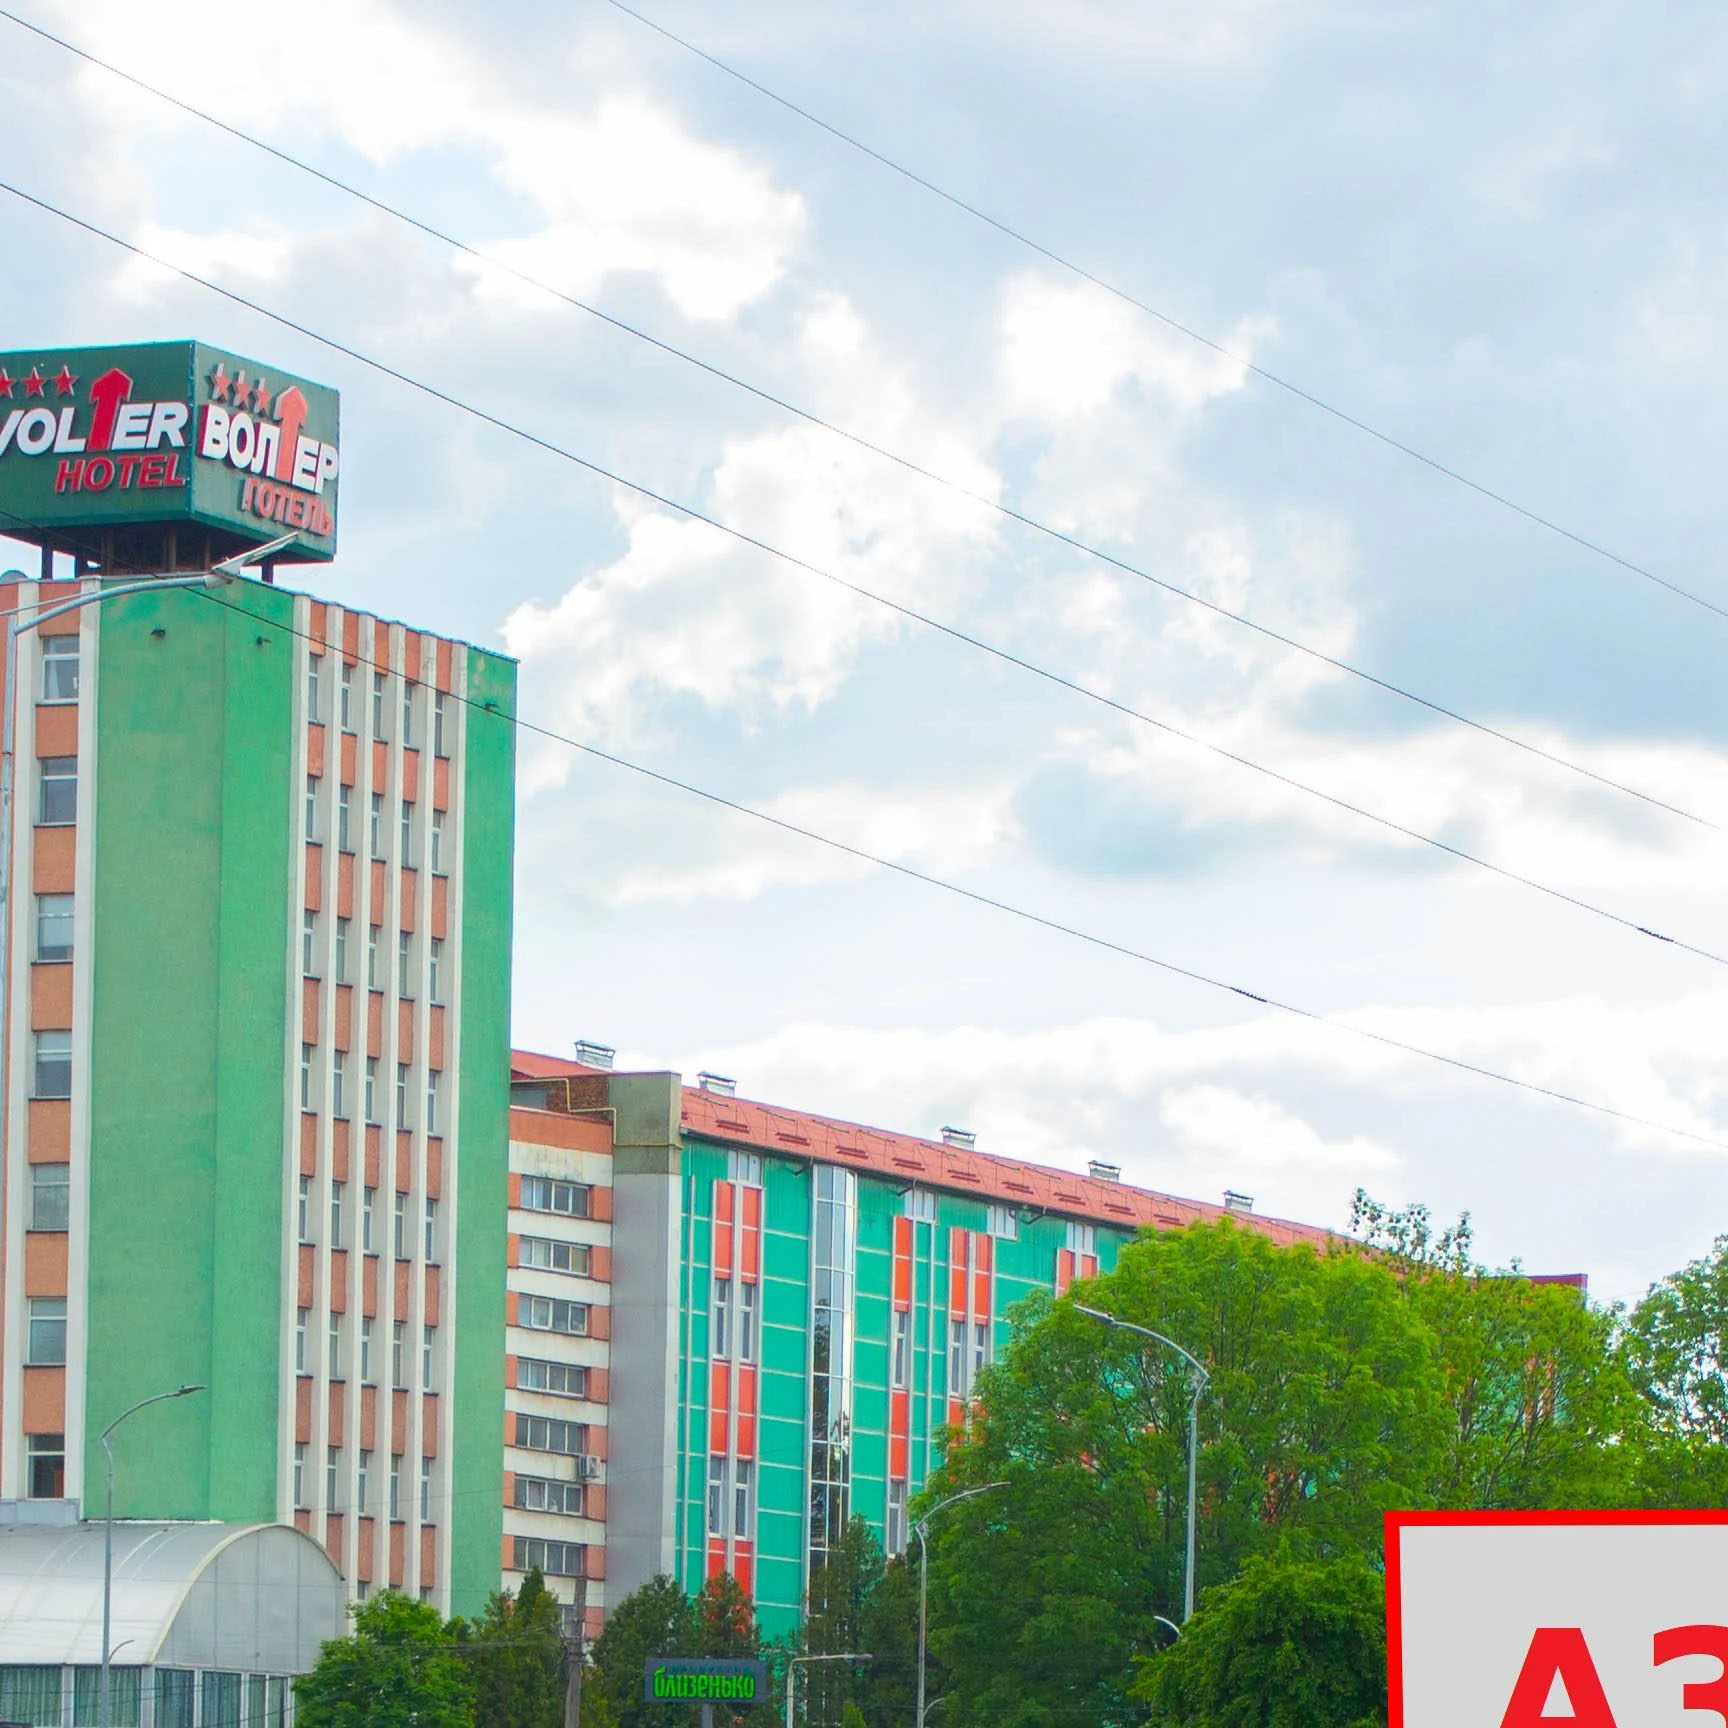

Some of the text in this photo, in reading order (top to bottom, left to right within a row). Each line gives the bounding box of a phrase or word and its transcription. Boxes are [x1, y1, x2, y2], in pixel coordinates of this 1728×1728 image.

[54, 453, 186, 494] HOTEL
[242, 478, 334, 537] ГОТЕЛЬ
[654, 1665, 756, 1699] близенько
